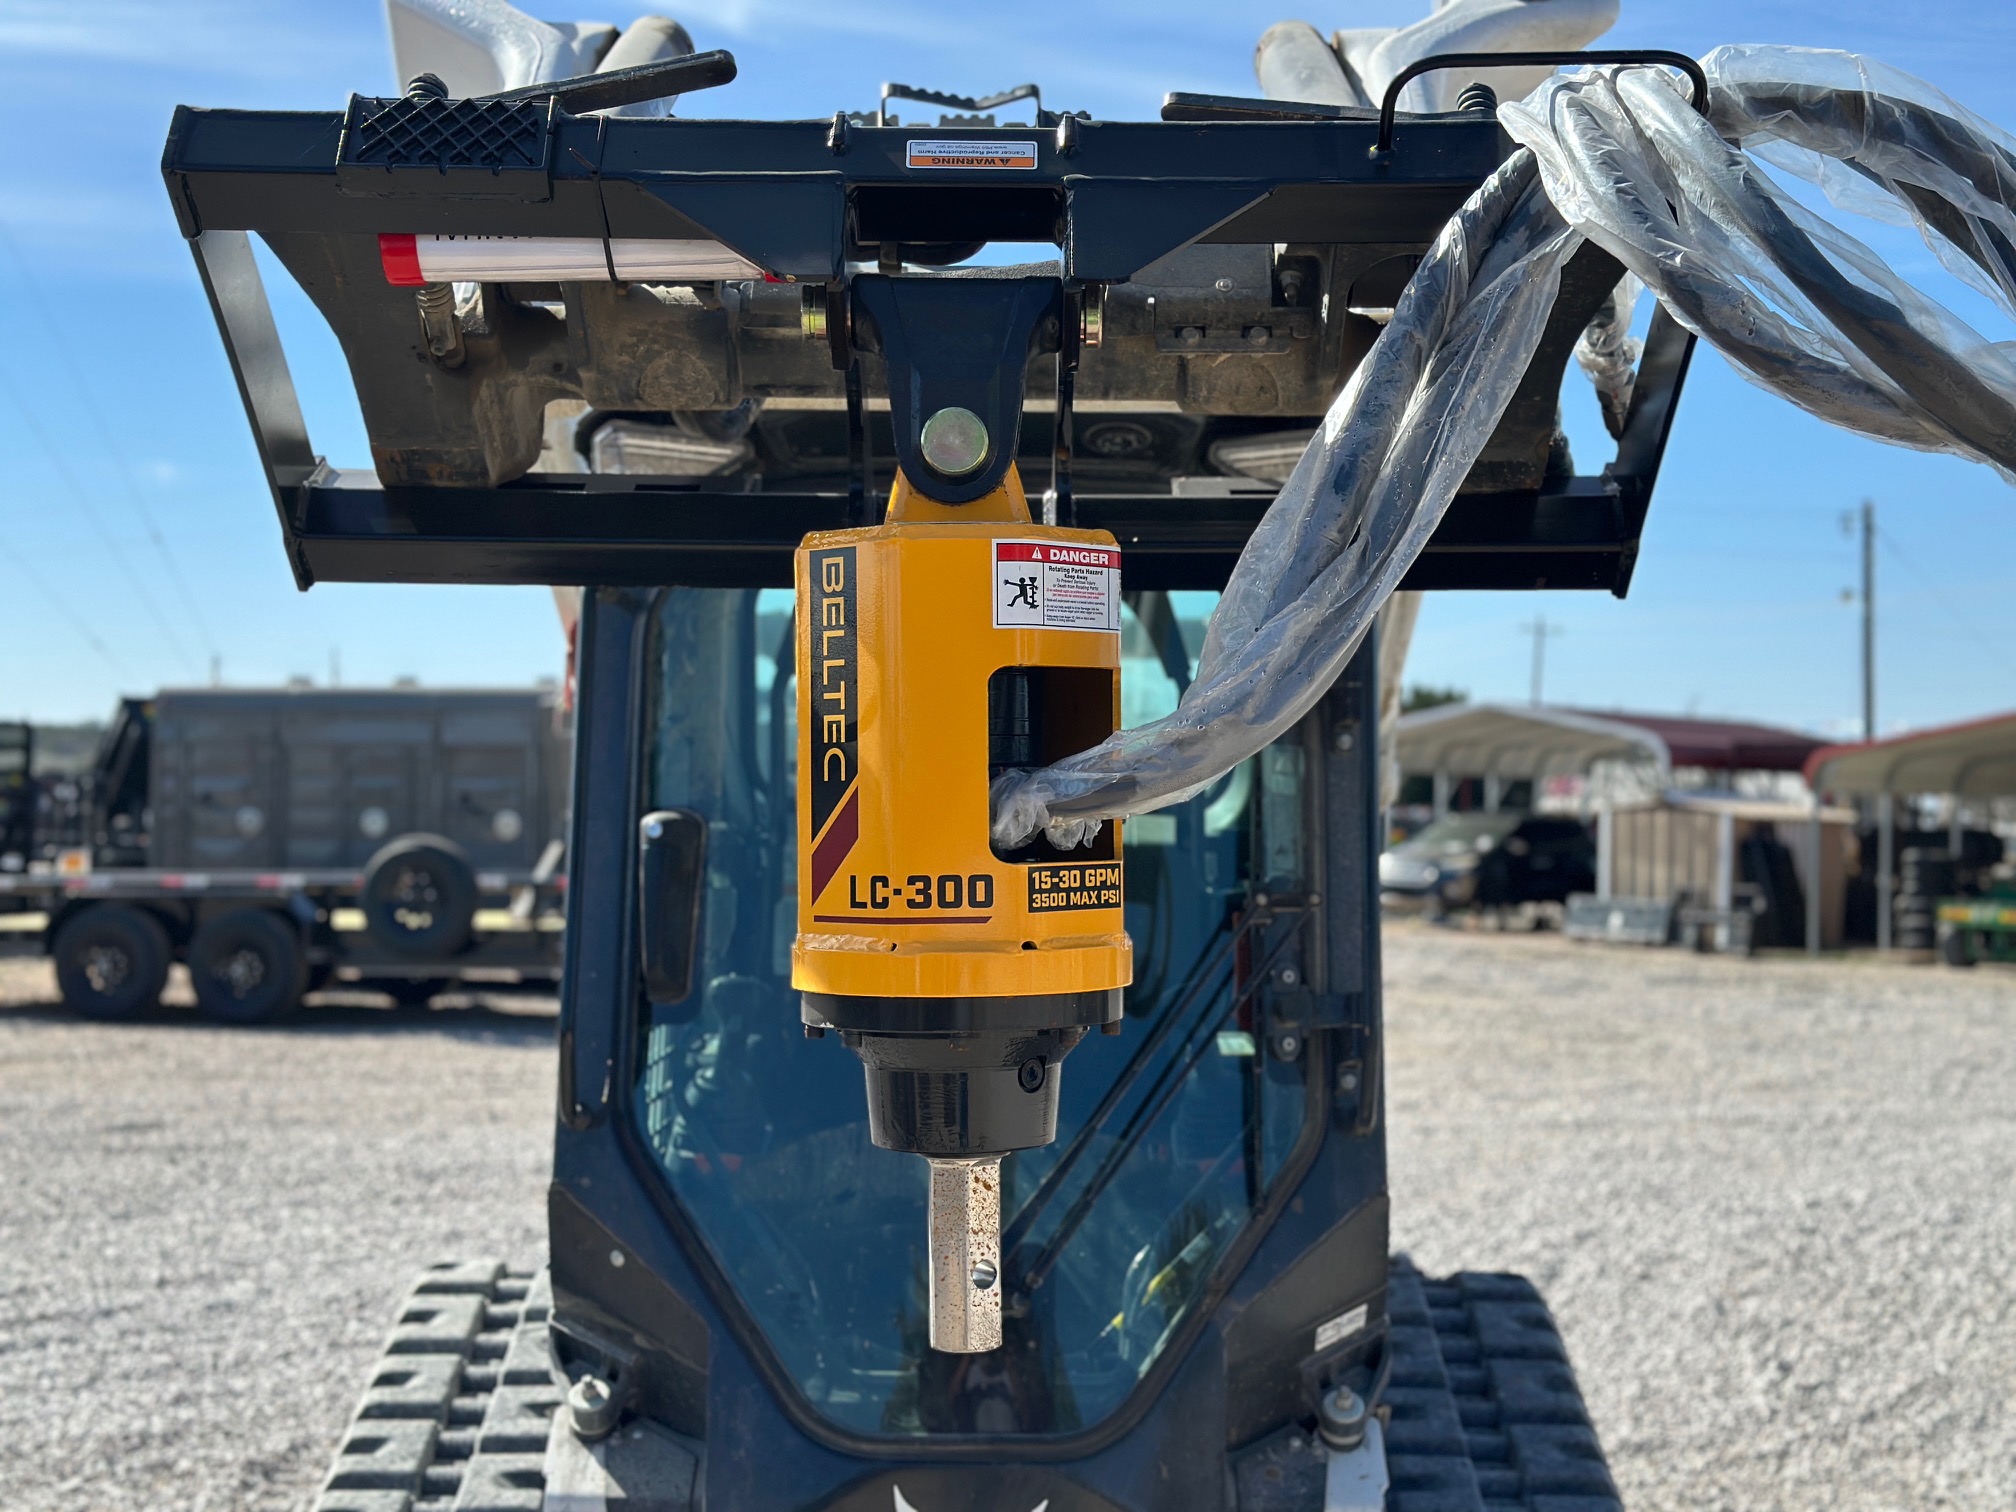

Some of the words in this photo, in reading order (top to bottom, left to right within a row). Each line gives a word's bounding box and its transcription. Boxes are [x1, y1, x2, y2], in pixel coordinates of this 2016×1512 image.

[1050, 549, 1108, 565] DANGER
[1048, 566, 1070, 574] Rotating
[822, 556, 846, 782] BELLTEC
[1032, 869, 1080, 890] 15-30
[1085, 868, 1120, 888] GPM
[850, 874, 994, 909] LC-300
[1032, 892, 1067, 908] 3500
[1069, 890, 1098, 906] MAX
[1100, 889, 1120, 904] PSI
